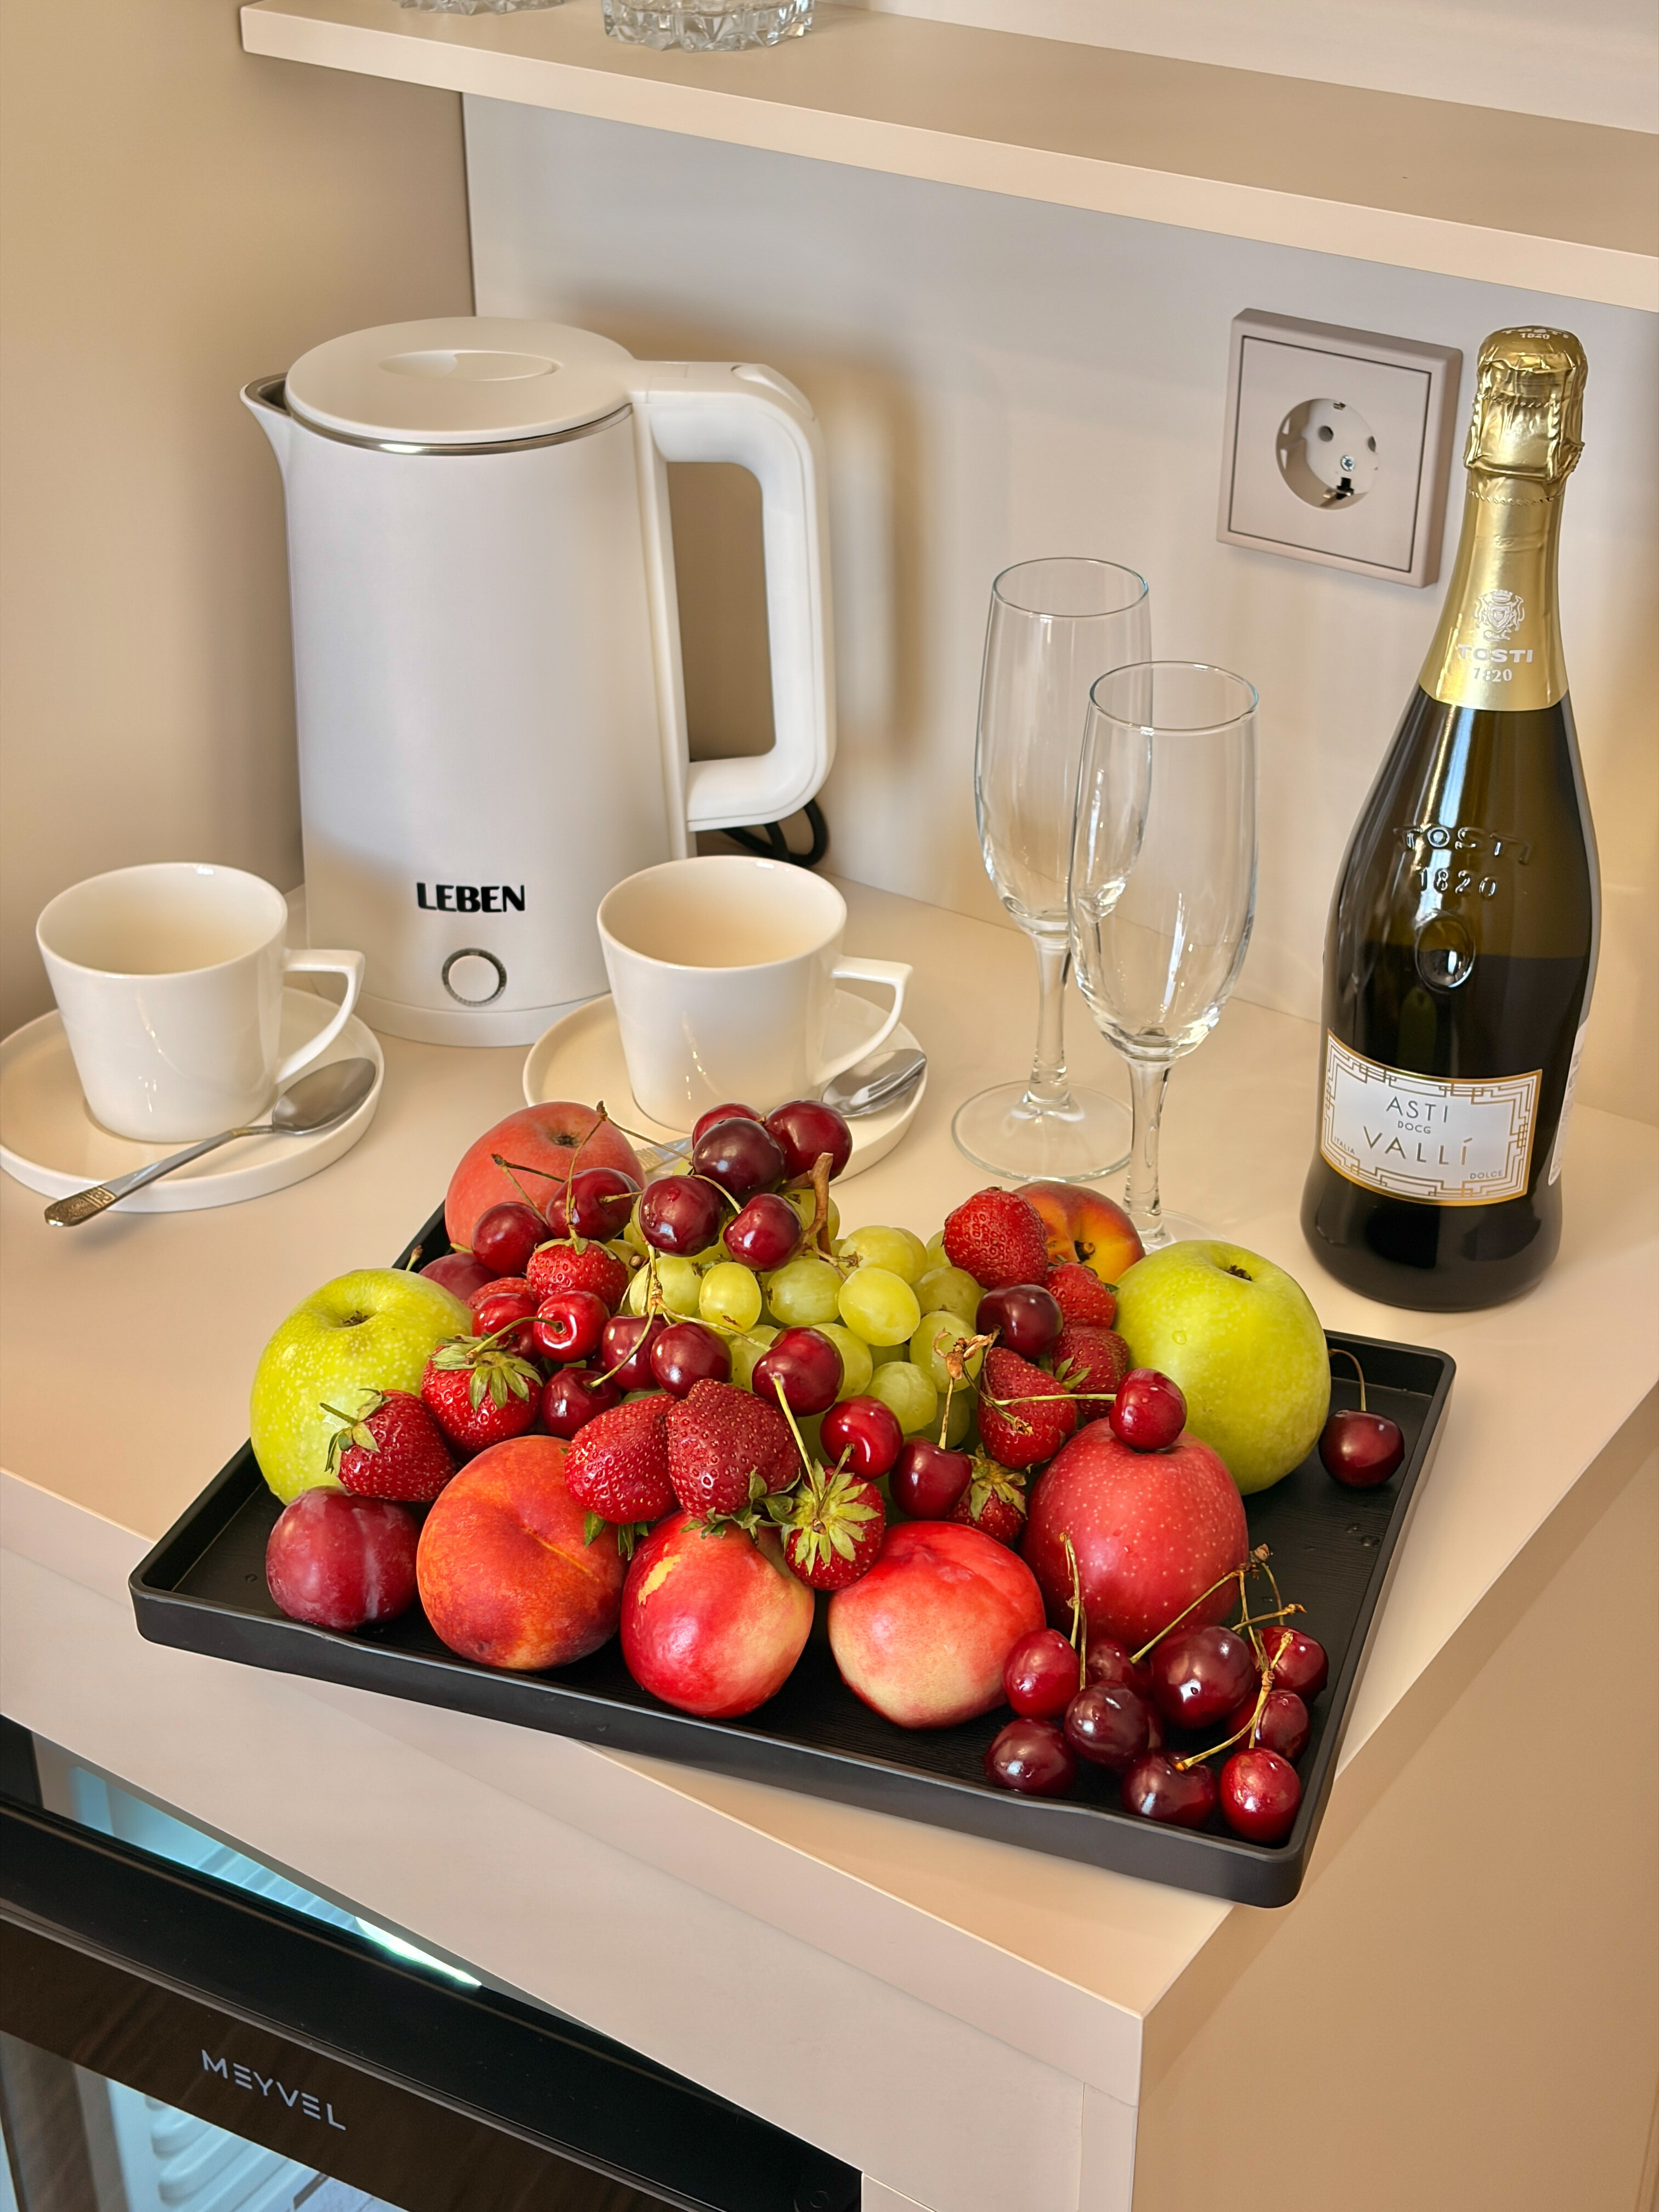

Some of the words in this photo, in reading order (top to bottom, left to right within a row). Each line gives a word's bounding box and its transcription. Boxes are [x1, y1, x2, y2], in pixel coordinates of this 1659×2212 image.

[1457, 644, 1533, 663] TOSTI
[1474, 667, 1513, 682] 1820
[1392, 825, 1531, 865] TOSTI
[416, 882, 525, 912] LEBEN
[1420, 867, 1497, 900] 1820
[1386, 1096, 1448, 1123] ASTI
[1398, 1121, 1431, 1134] DOCG
[1334, 1136, 1355, 1155] ITALIA
[1363, 1126, 1473, 1165] VALLÍ
[1470, 1170, 1503, 1180] DOLCE
[201, 2049, 346, 2131] MEYVEL
